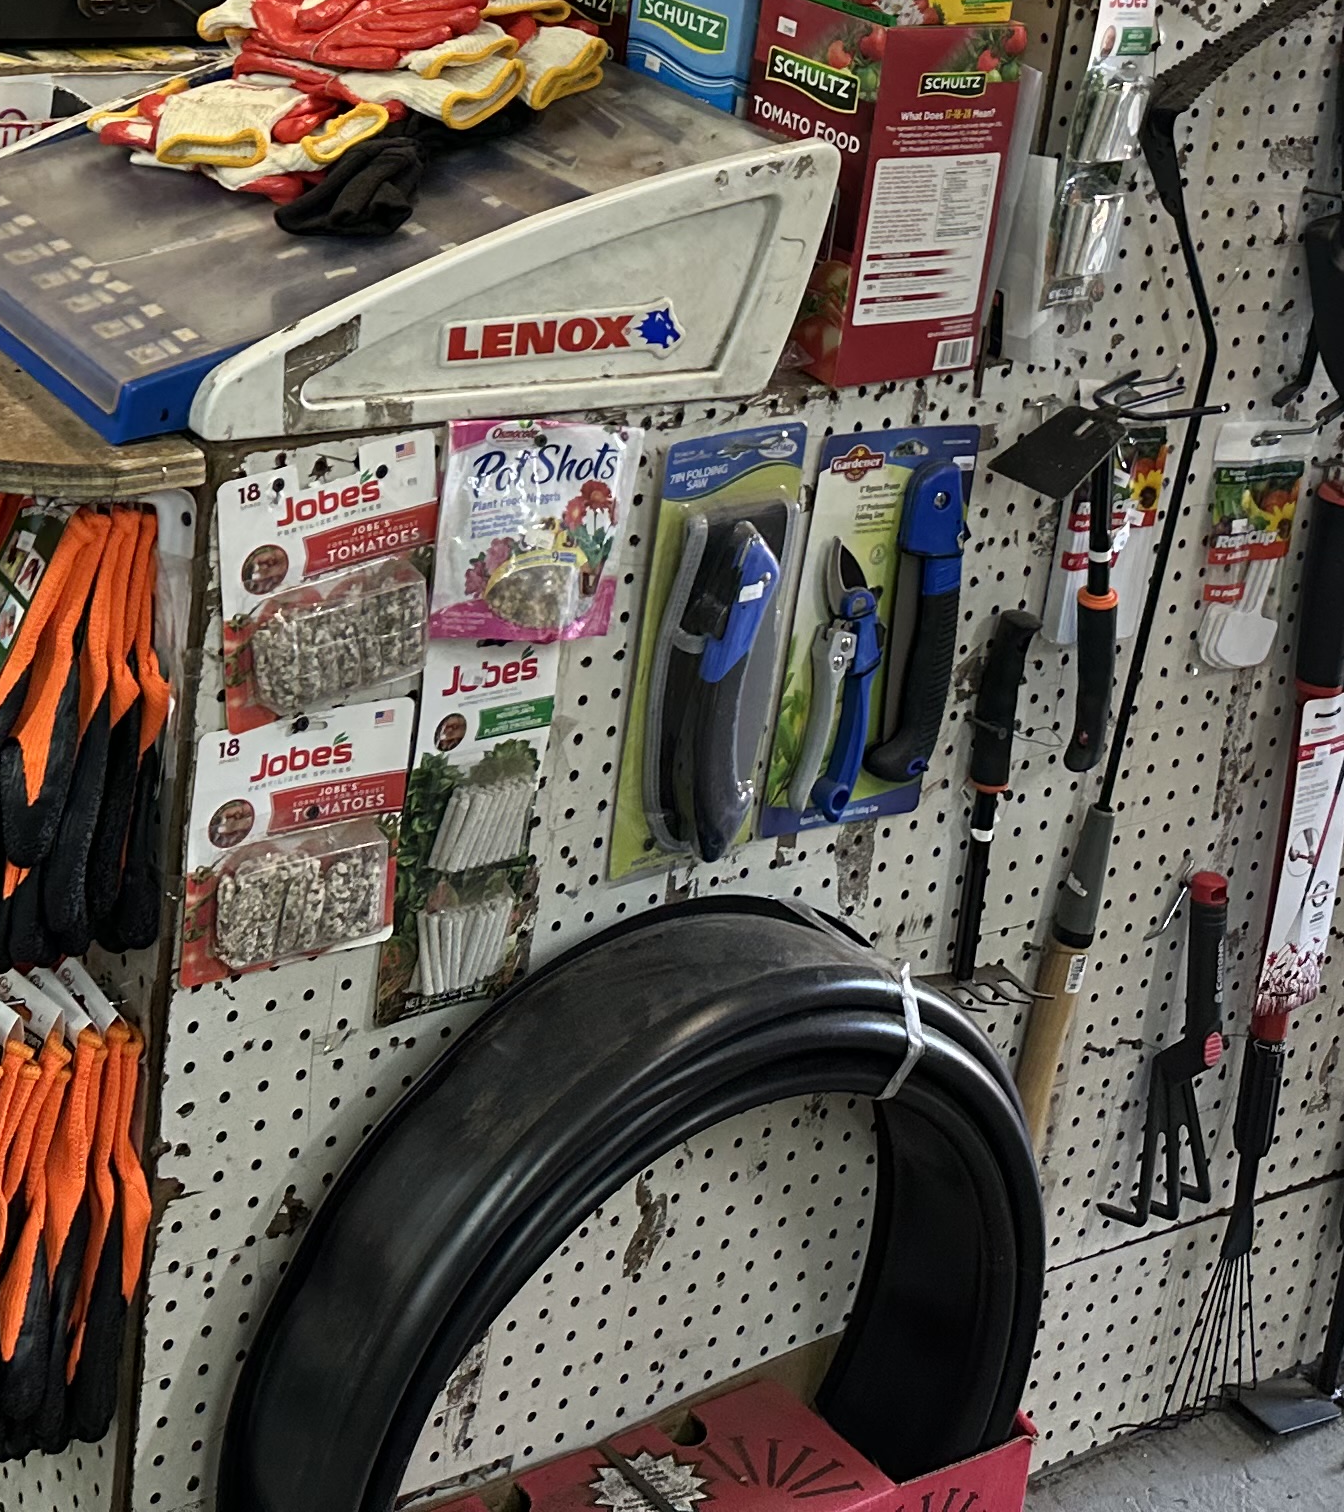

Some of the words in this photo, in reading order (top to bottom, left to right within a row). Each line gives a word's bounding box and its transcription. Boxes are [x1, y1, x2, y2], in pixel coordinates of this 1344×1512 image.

[773, 54, 854, 100] SCHULTZ
[924, 74, 982, 90] SCHULTZ
[753, 95, 811, 135] TOMATO
[814, 118, 861, 155] FOOD
[900, 110, 921, 121] What
[922, 109, 944, 121] Does
[972, 108, 996, 120] Mean?
[446, 314, 632, 363] LENOX
[531, 442, 620, 485] Shots
[686, 463, 729, 481] FOLDING
[833, 456, 883, 472] Gardener
[237, 482, 262, 505] 18
[685, 476, 709, 491] SAW
[471, 498, 498, 513] Plant
[276, 514, 340, 537] FERTILIZER
[343, 502, 383, 519] SPIKES
[351, 518, 392, 536] JOBE'S
[326, 527, 421, 564] TOMATOES
[1214, 528, 1279, 549] RapiClip
[218, 737, 241, 759] 18
[247, 772, 310, 793] FERTILIZER
[312, 765, 353, 779] SPIKES
[317, 782, 358, 798] JOBE'S
